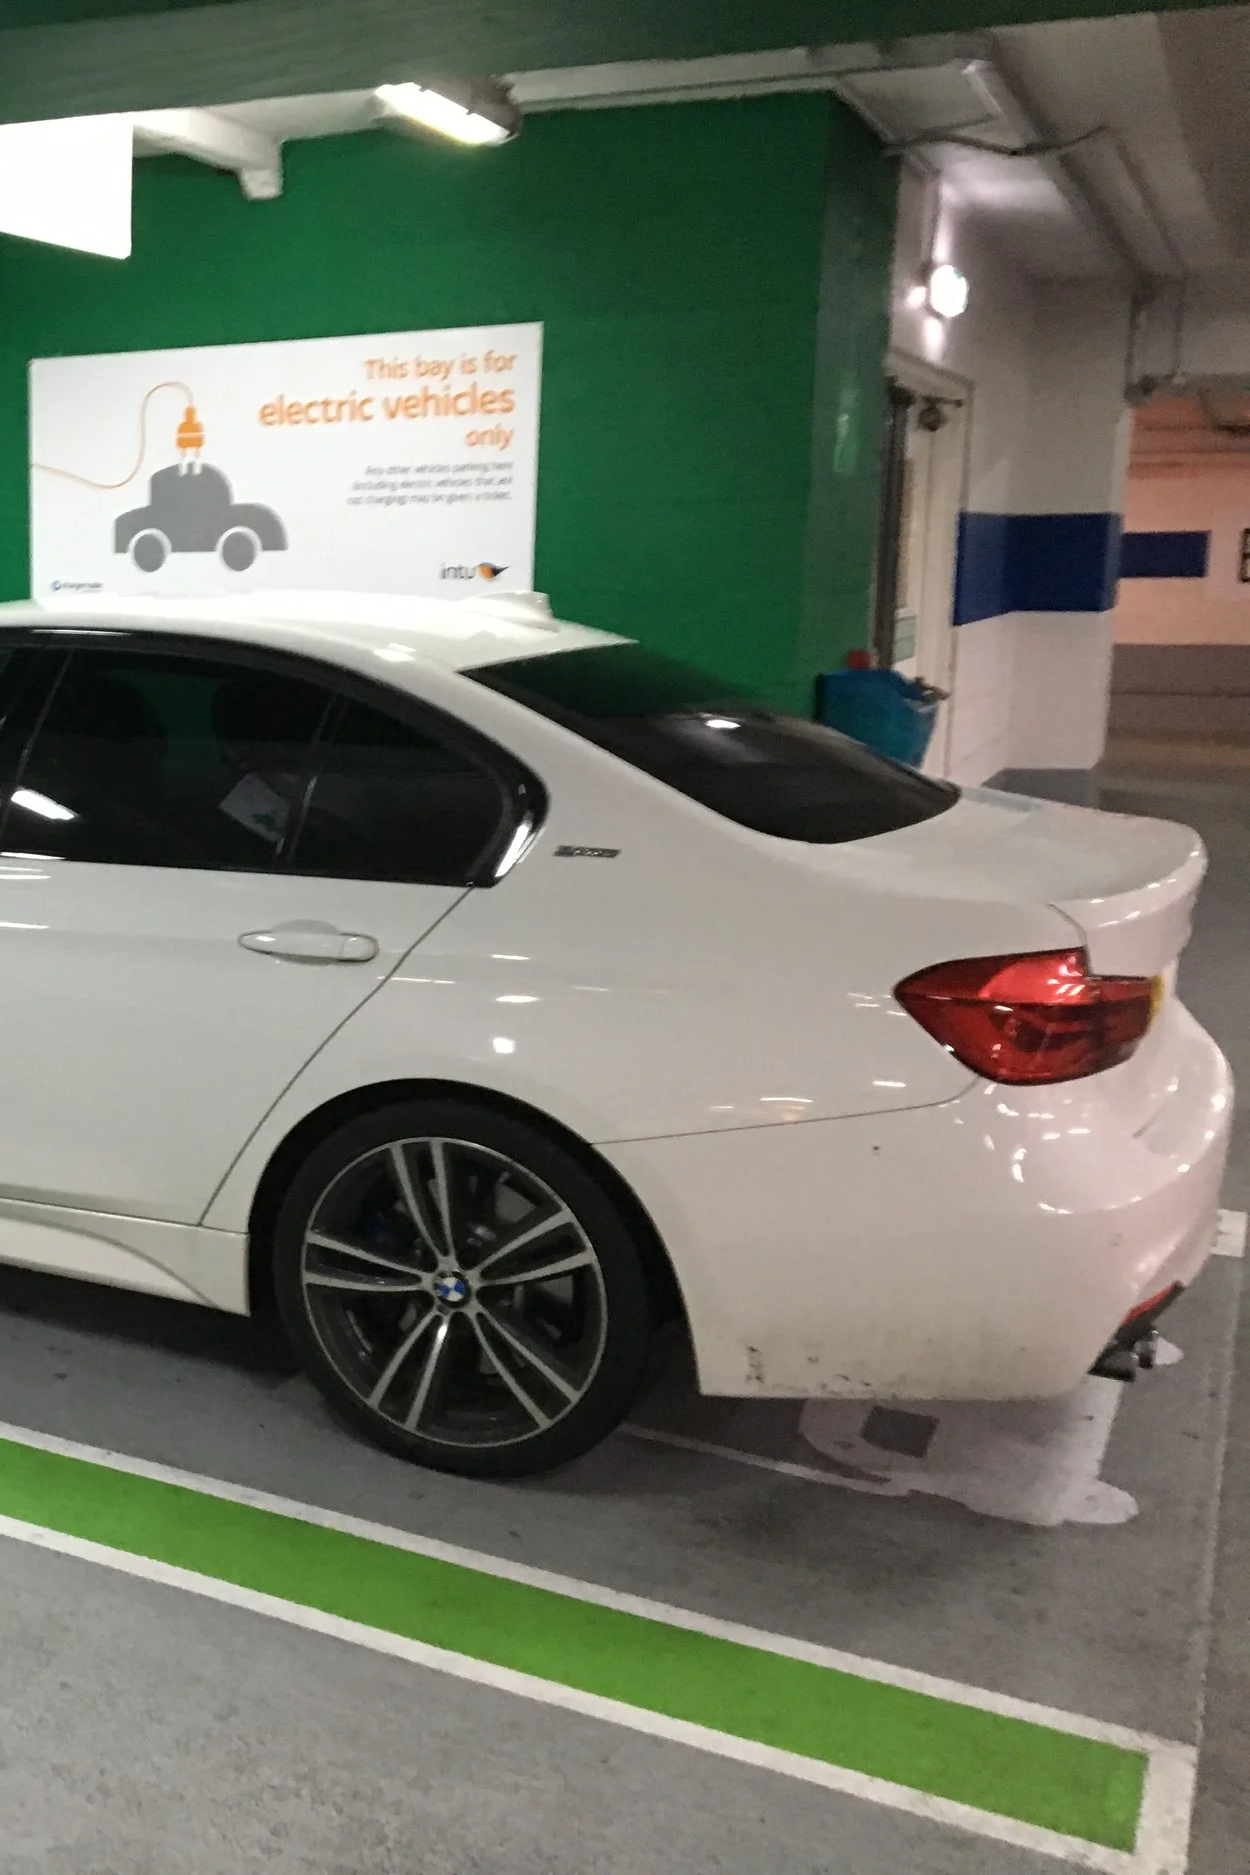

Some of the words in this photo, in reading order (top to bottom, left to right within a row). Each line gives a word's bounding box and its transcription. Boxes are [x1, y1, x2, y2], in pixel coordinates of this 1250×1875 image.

[364, 357, 409, 380] This
[414, 355, 455, 381] bay
[460, 352, 477, 375] is
[483, 349, 517, 373] for
[259, 389, 375, 427] electric
[382, 381, 516, 420] vehicles
[464, 423, 515, 451] only
[438, 561, 476, 580] intu
